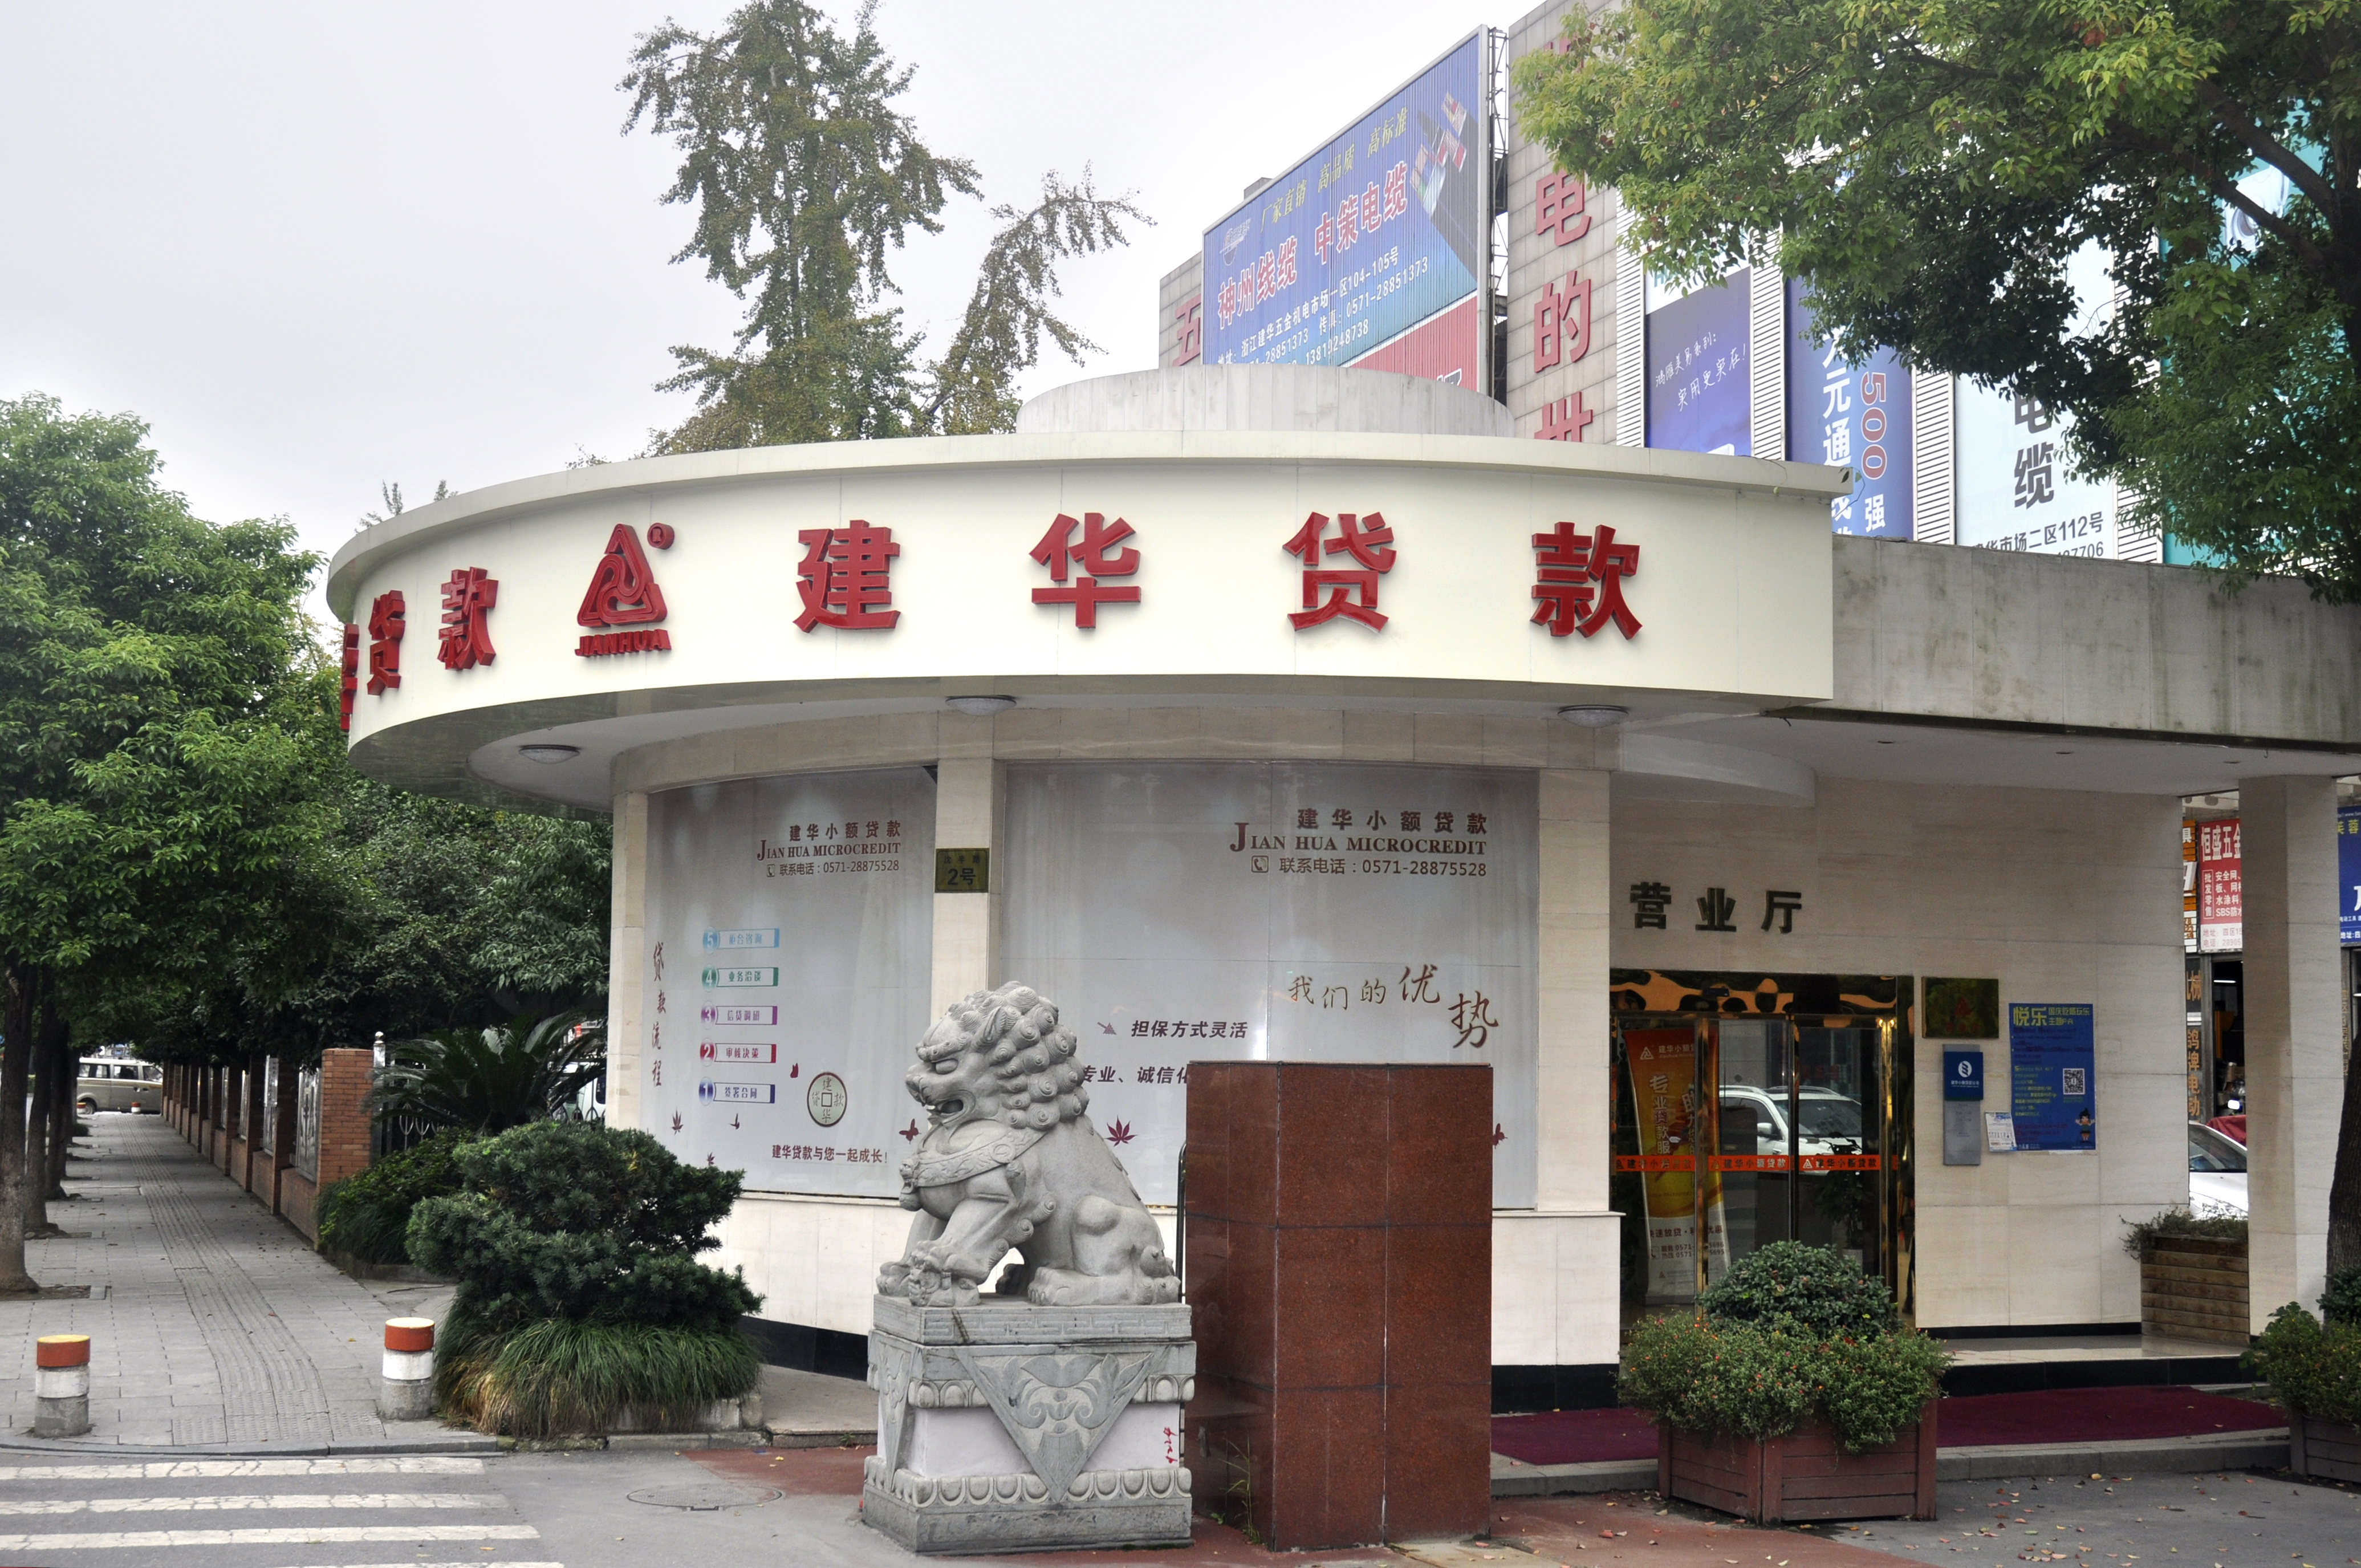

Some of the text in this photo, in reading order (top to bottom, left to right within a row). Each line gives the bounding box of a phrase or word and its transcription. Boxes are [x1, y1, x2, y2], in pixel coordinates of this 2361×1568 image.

[1367, 107, 1408, 158] 高标准
[1318, 144, 1355, 193] 高品质
[1260, 178, 1306, 233] 厂家直销
[1315, 161, 1407, 265] 中策电缆
[1218, 235, 1297, 330] 神州线缆
[1172, 293, 1201, 367] 五
[793, 511, 1643, 640] 建华贷款
[575, 628, 672, 657] JIANHUA
[789, 820, 901, 842] 建华小额贷款
[1296, 808, 1488, 835] 建华小额贷款
[787, 846, 810, 858] HUA
[813, 842, 901, 856] MICROCREDIT
[1294, 836, 1338, 851] HUA
[1346, 837, 1487, 855] MICROCREDIT
[947, 868, 976, 885] 2号
[1630, 882, 1802, 934] 营业厅
[729, 970, 761, 982] 业务洽谈
[727, 1010, 760, 1021] 信贷调研
[1287, 964, 1498, 1049] 我们的优势
[2013, 1006, 2047, 1026] 悦乐
[1131, 1019, 1247, 1038] 担保方式灵活
[726, 1047, 759, 1058] 审核决策
[725, 1087, 757, 1098] 签署合同
[772, 1144, 888, 1164] 建华贷款与您一起成长！
